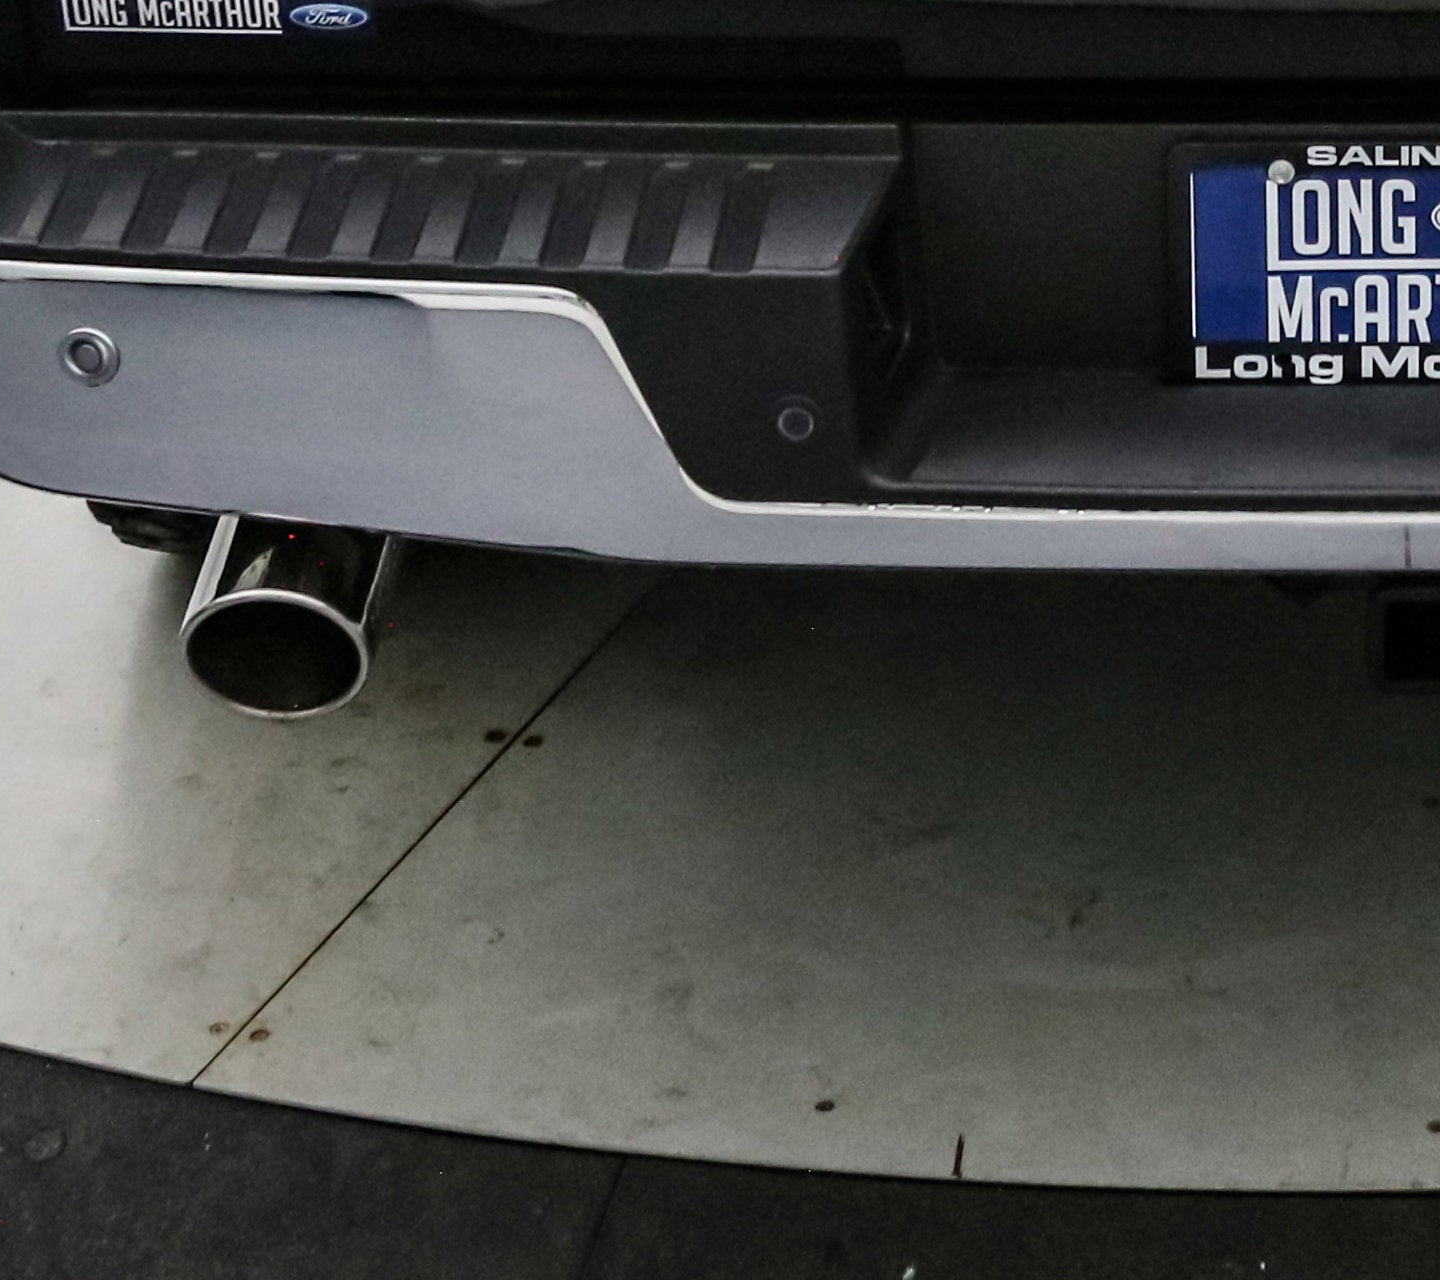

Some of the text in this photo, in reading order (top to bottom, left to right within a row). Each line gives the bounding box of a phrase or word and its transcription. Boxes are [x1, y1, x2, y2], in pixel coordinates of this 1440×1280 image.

[304, 8, 353, 26] Ford
[1266, 178, 1417, 269] LONG
[1194, 345, 1345, 384] Long
